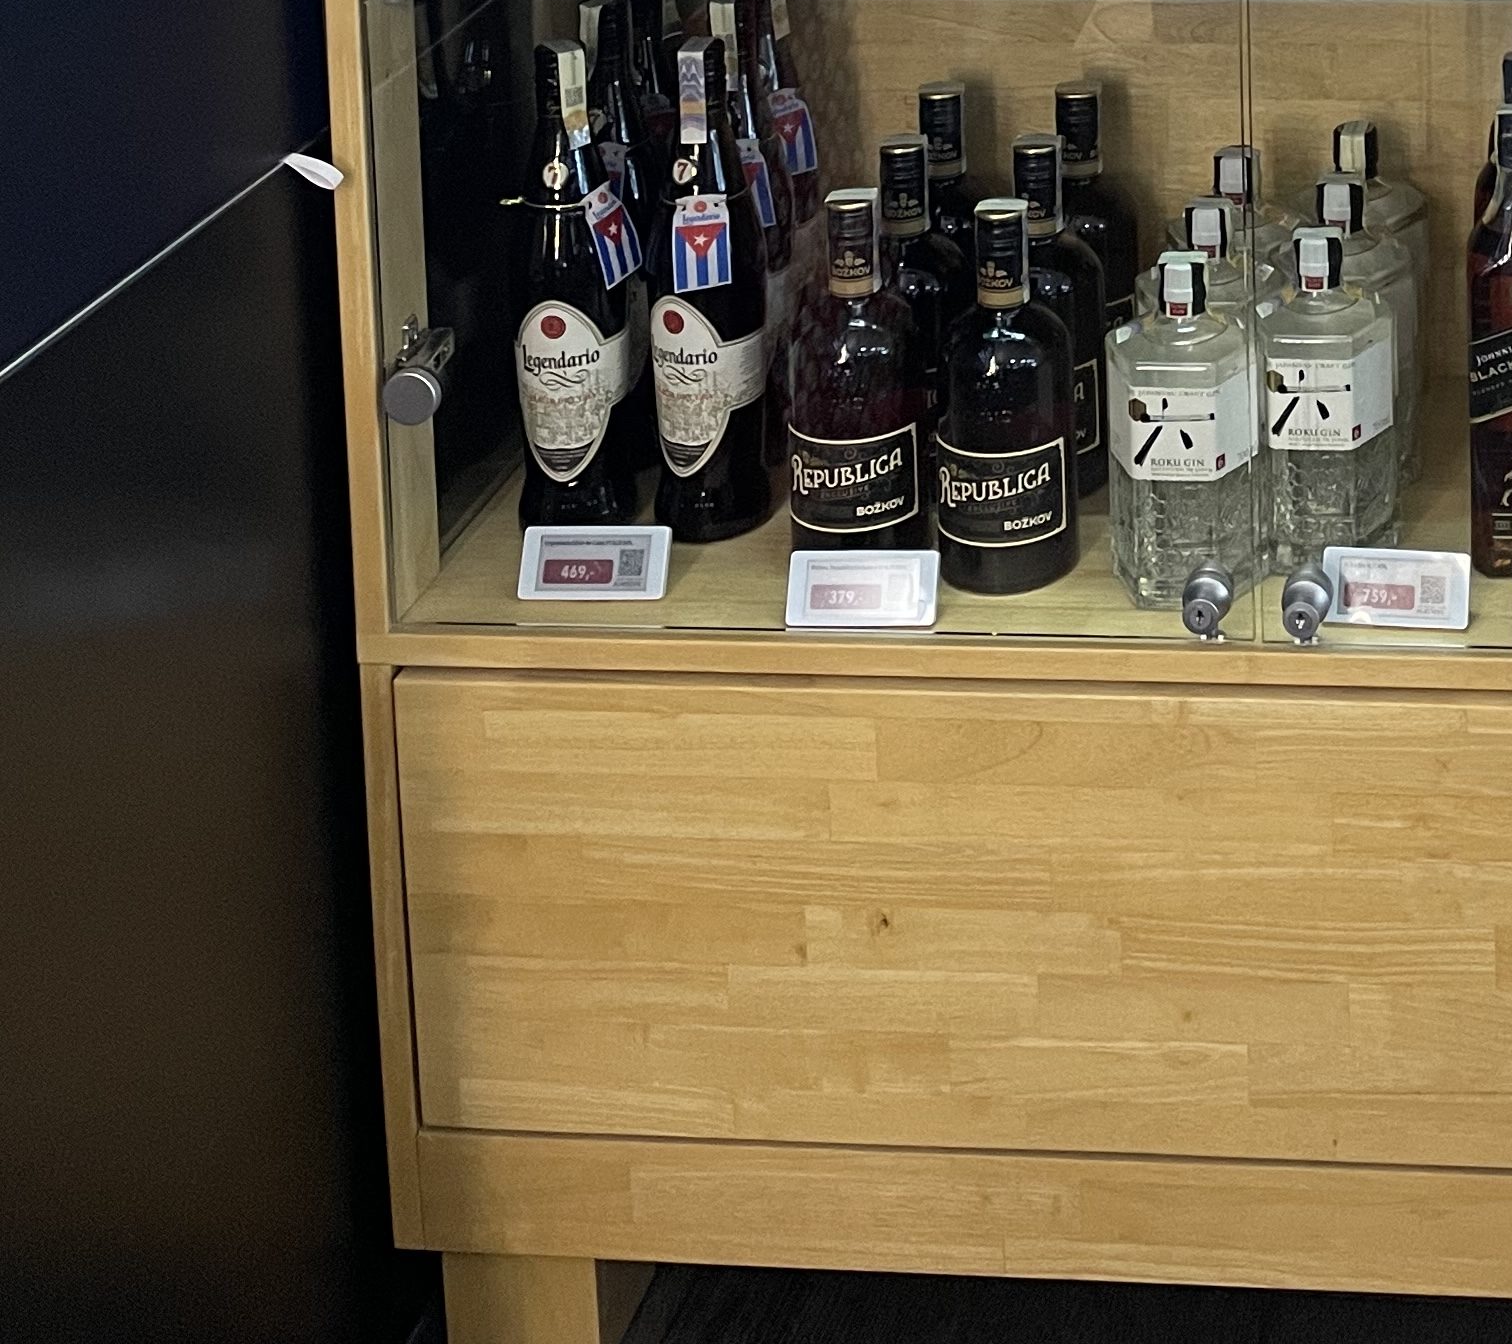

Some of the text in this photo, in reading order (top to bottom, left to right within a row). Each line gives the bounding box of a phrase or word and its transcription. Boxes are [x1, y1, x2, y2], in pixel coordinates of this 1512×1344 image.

[678, 163, 688, 181] 7
[523, 345, 600, 376] Legendario
[1288, 428, 1341, 436] ROKU GIN
[1150, 458, 1205, 467] ROKU GIN
[791, 452, 903, 495] REPUBLICA
[940, 466, 1051, 507] REPUBLICA
[856, 495, 905, 517] BOŽKOV
[1003, 510, 1053, 531] BOŽKOV
[561, 564, 595, 580] 469,-
[829, 590, 864, 604] 379,-
[1362, 589, 1397, 605] 759,-
